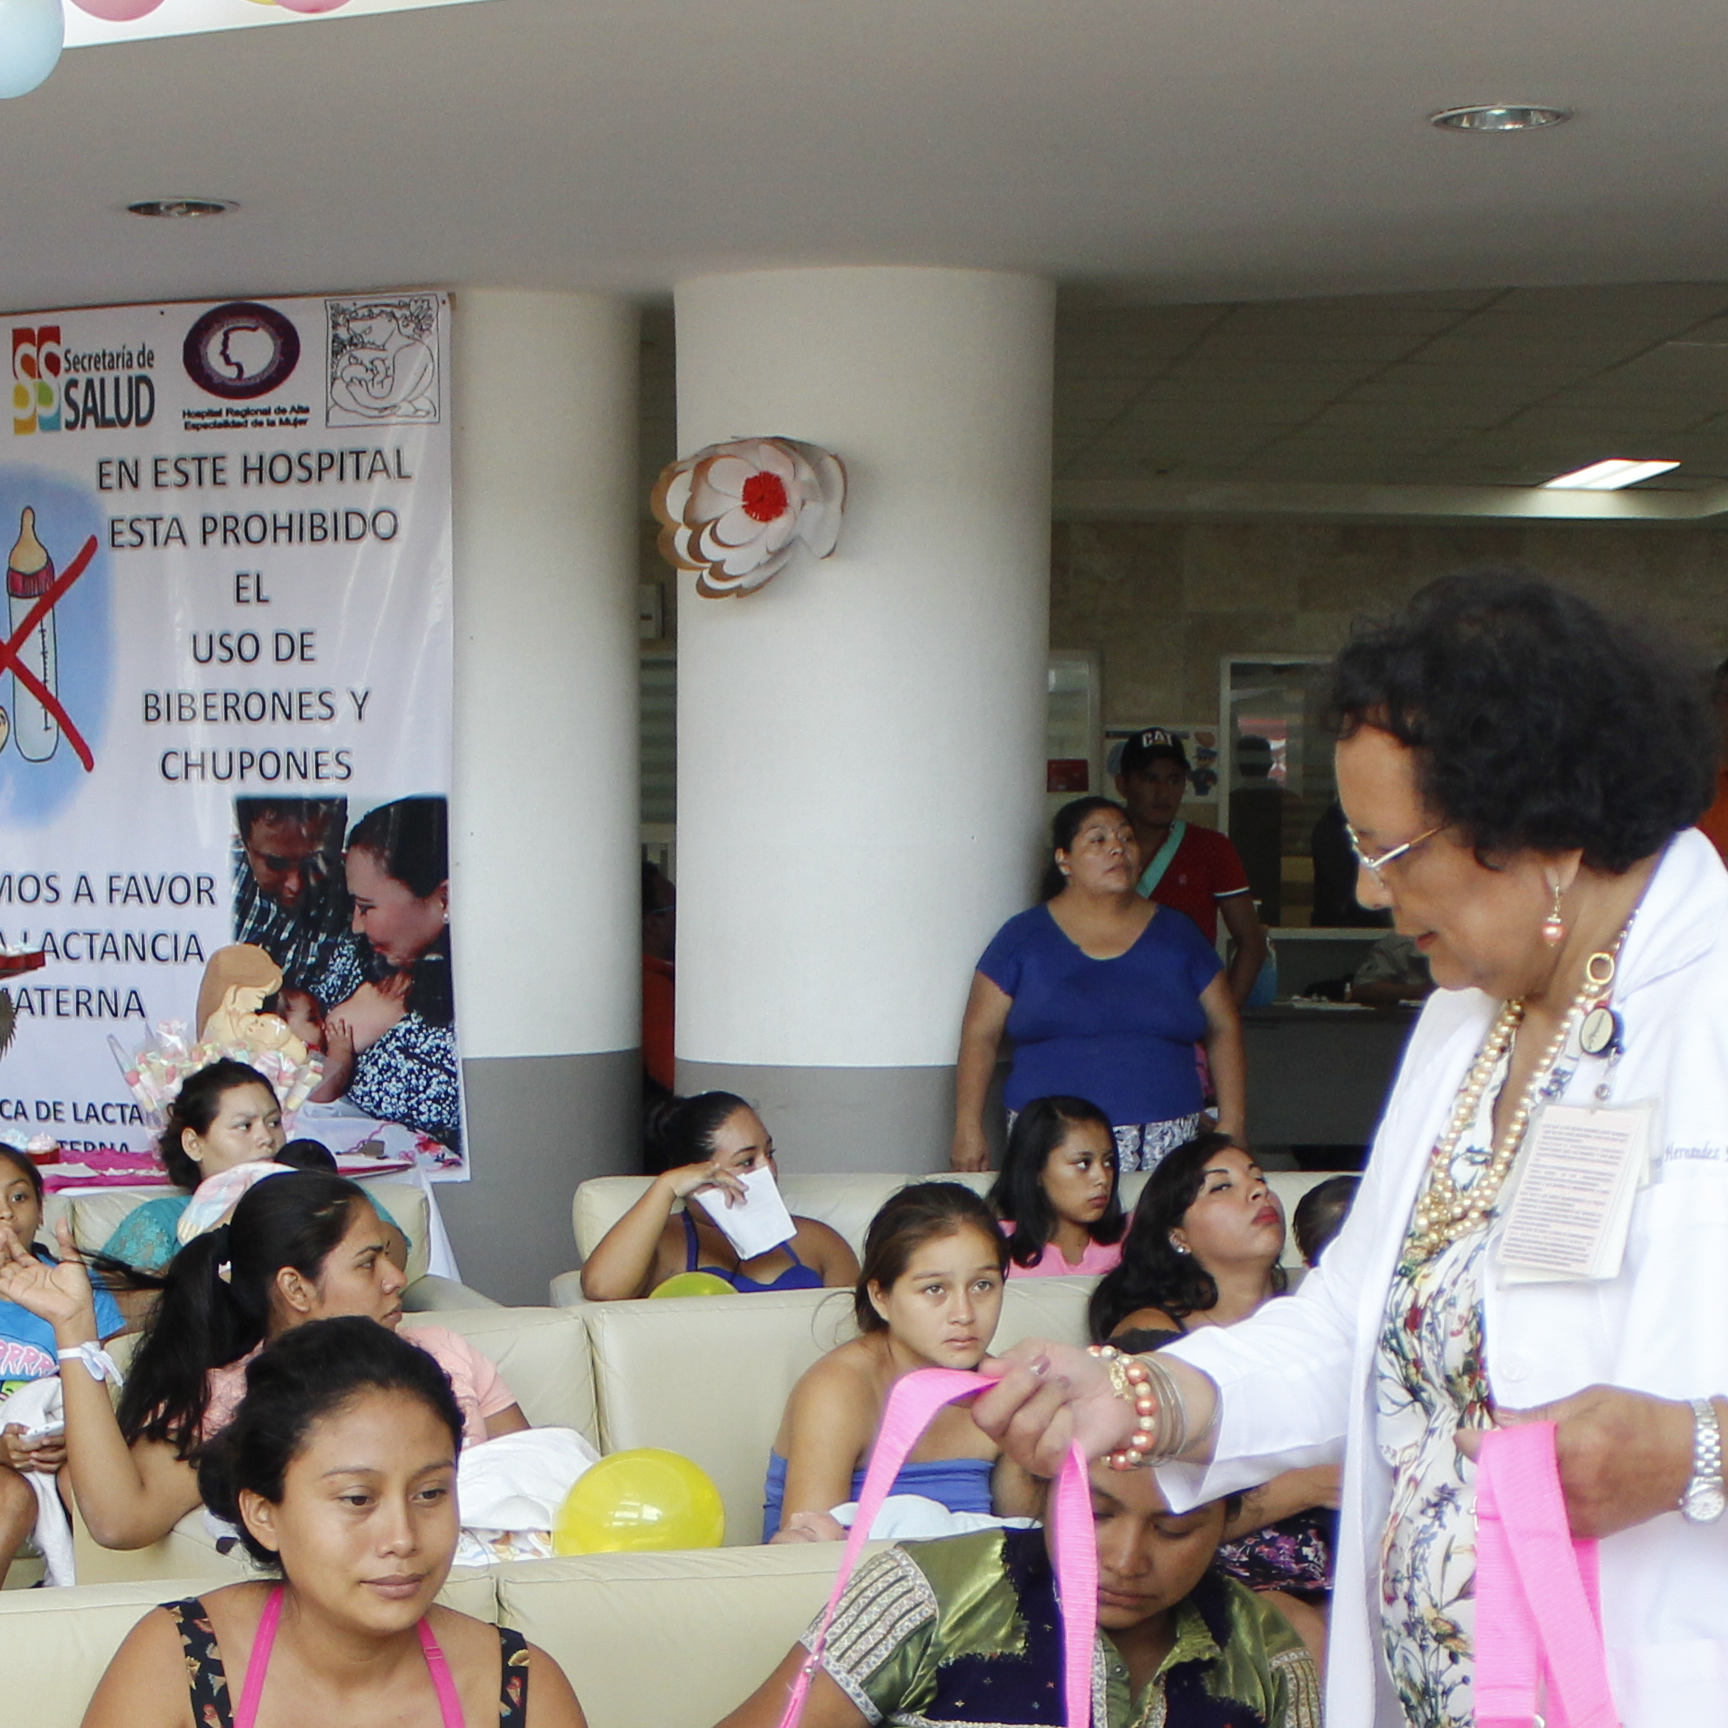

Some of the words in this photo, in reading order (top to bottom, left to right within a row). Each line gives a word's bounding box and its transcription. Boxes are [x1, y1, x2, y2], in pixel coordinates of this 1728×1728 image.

[64, 343, 133, 373] Secretaría
[137, 348, 155, 368] de
[64, 374, 155, 431] SALUD
[183, 408, 223, 420] Hospital
[226, 406, 271, 419] Regional
[274, 405, 288, 416] de
[290, 404, 312, 415] Alta
[251, 418, 264, 428] de
[266, 418, 277, 427] la
[278, 416, 308, 429] Mujer
[97, 459, 140, 490] EN
[153, 456, 226, 487] ESTE
[242, 449, 412, 485] HOSPITAL
[109, 517, 187, 549] ESTA
[201, 509, 400, 547] PROHIBIDO
[235, 573, 270, 604] EL
[192, 632, 260, 663] USO
[274, 631, 317, 662] DE
[143, 691, 335, 723] BIBERONES
[349, 690, 370, 722] Y
[1142, 730, 1173, 748] CAT
[160, 750, 353, 781] CHUPONES
[74, 875, 95, 904] A
[109, 875, 217, 906] FAVOR
[35, 1100, 65, 1122] DE
[73, 1102, 160, 1126] LACTA
